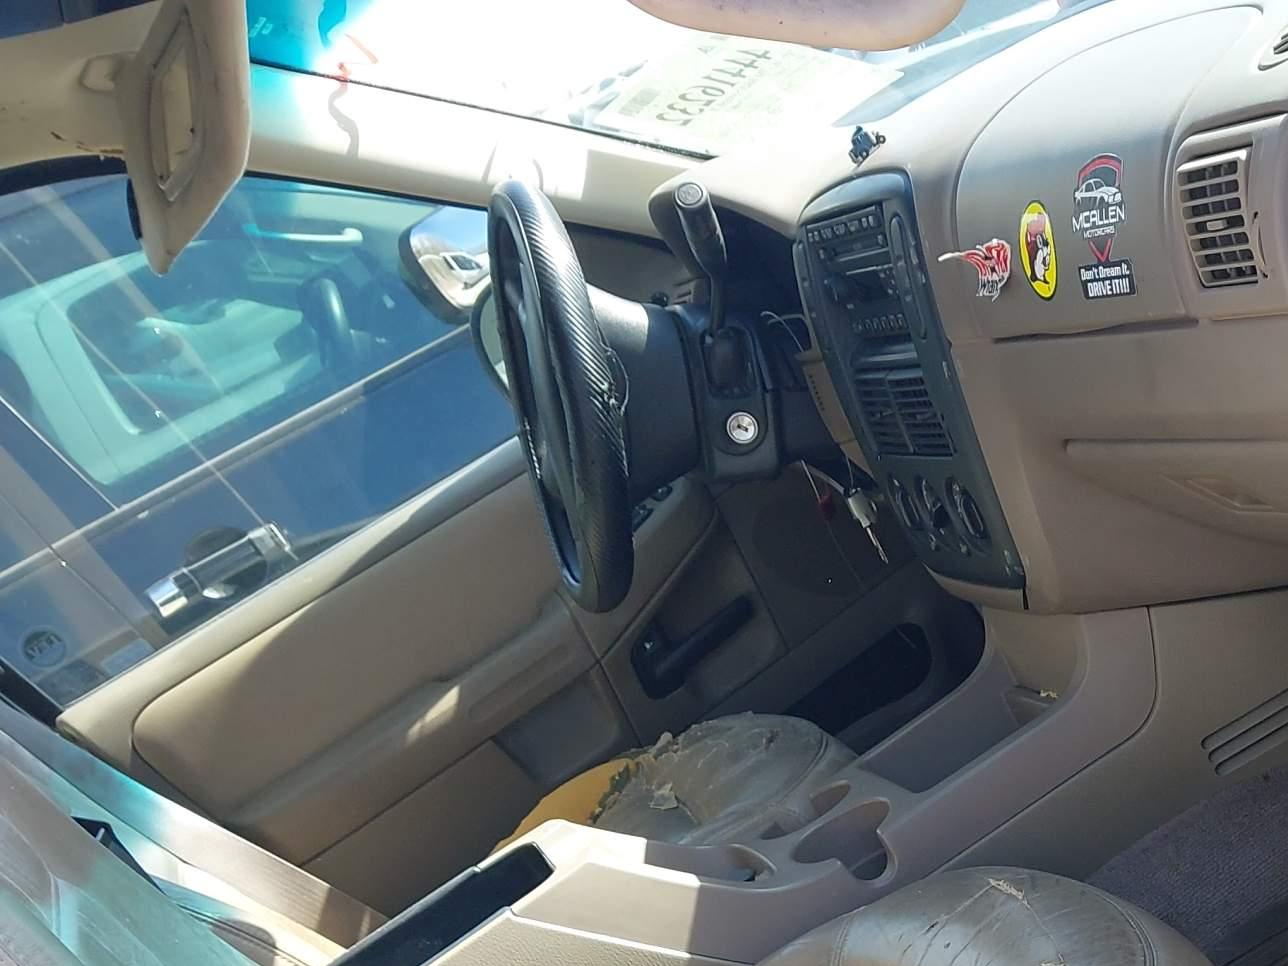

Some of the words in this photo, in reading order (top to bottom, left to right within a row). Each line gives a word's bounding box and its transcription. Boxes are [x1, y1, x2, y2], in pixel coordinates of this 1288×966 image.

[1072, 204, 1125, 232] MCALLEN
[1080, 267, 1099, 281] Don't
[1099, 265, 1121, 278] Dream
[1087, 280, 1112, 297] DRIVE
